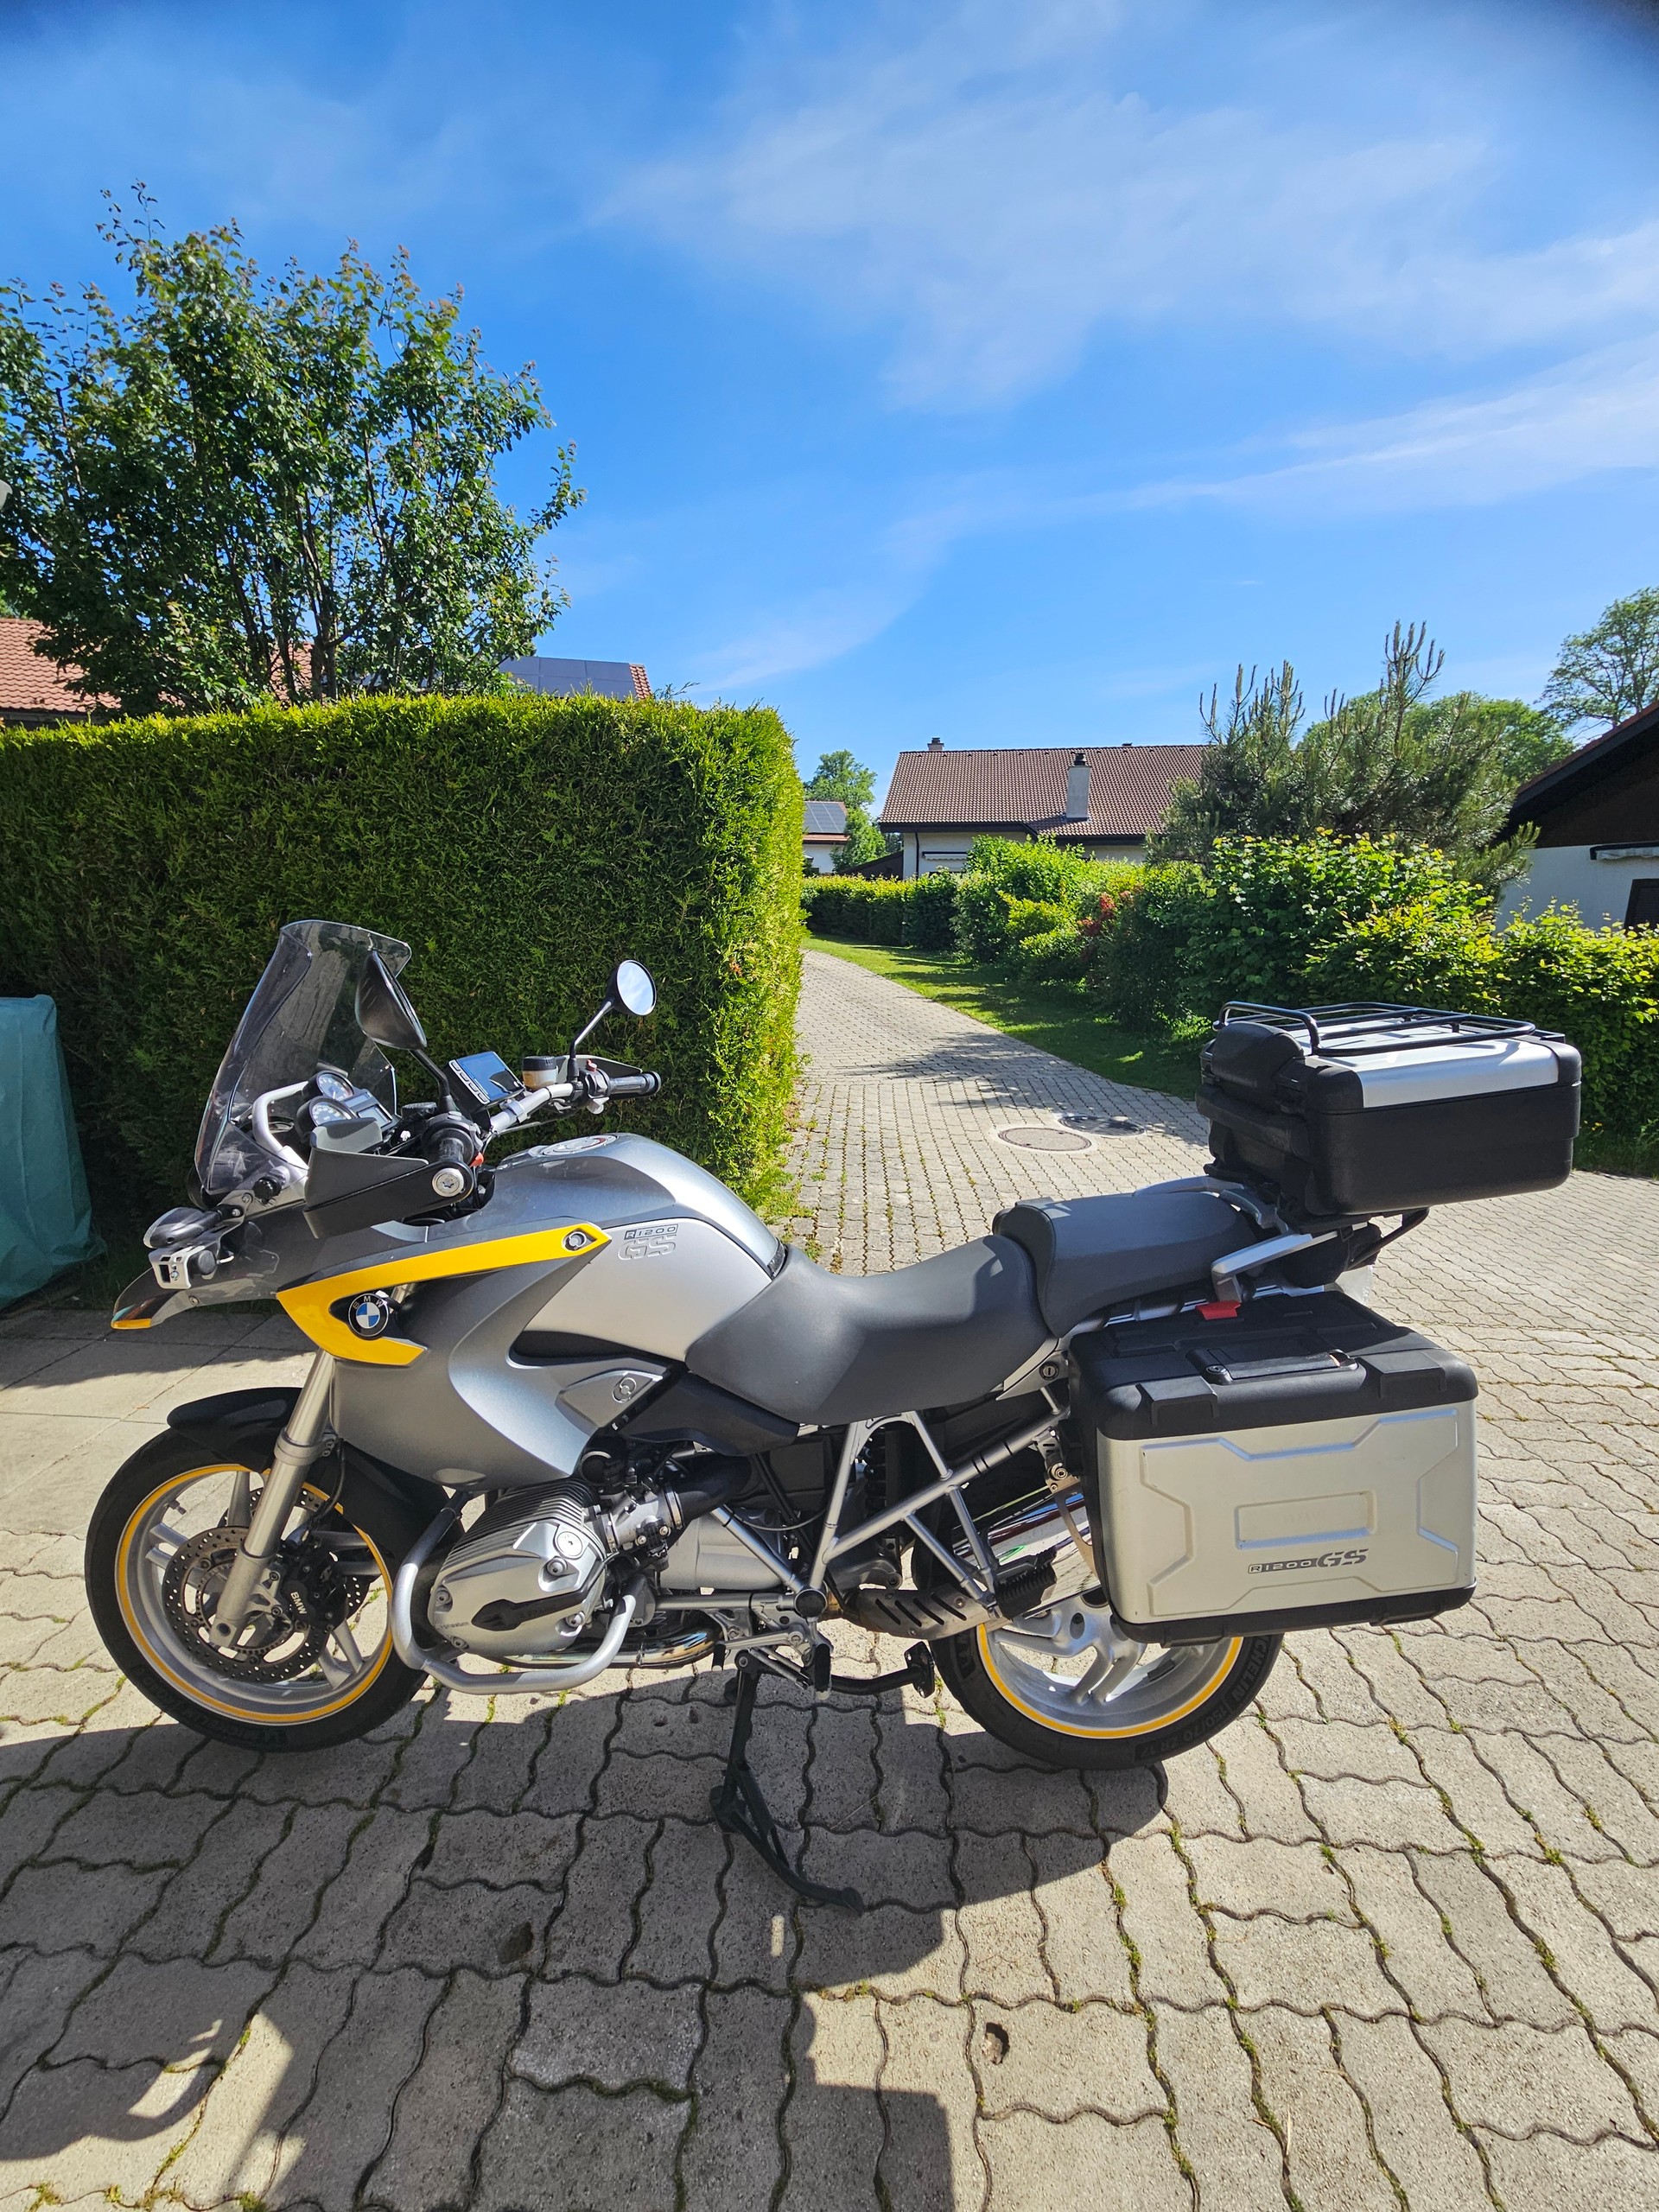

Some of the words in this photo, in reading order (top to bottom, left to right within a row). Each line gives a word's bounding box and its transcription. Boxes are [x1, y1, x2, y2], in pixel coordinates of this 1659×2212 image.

[625, 1225, 677, 1239] R1200
[618, 1235, 677, 1260] GS
[353, 1295, 384, 1310] BMW
[290, 1591, 308, 1614] BMW
[1179, 1705, 1230, 1743] 150/70
